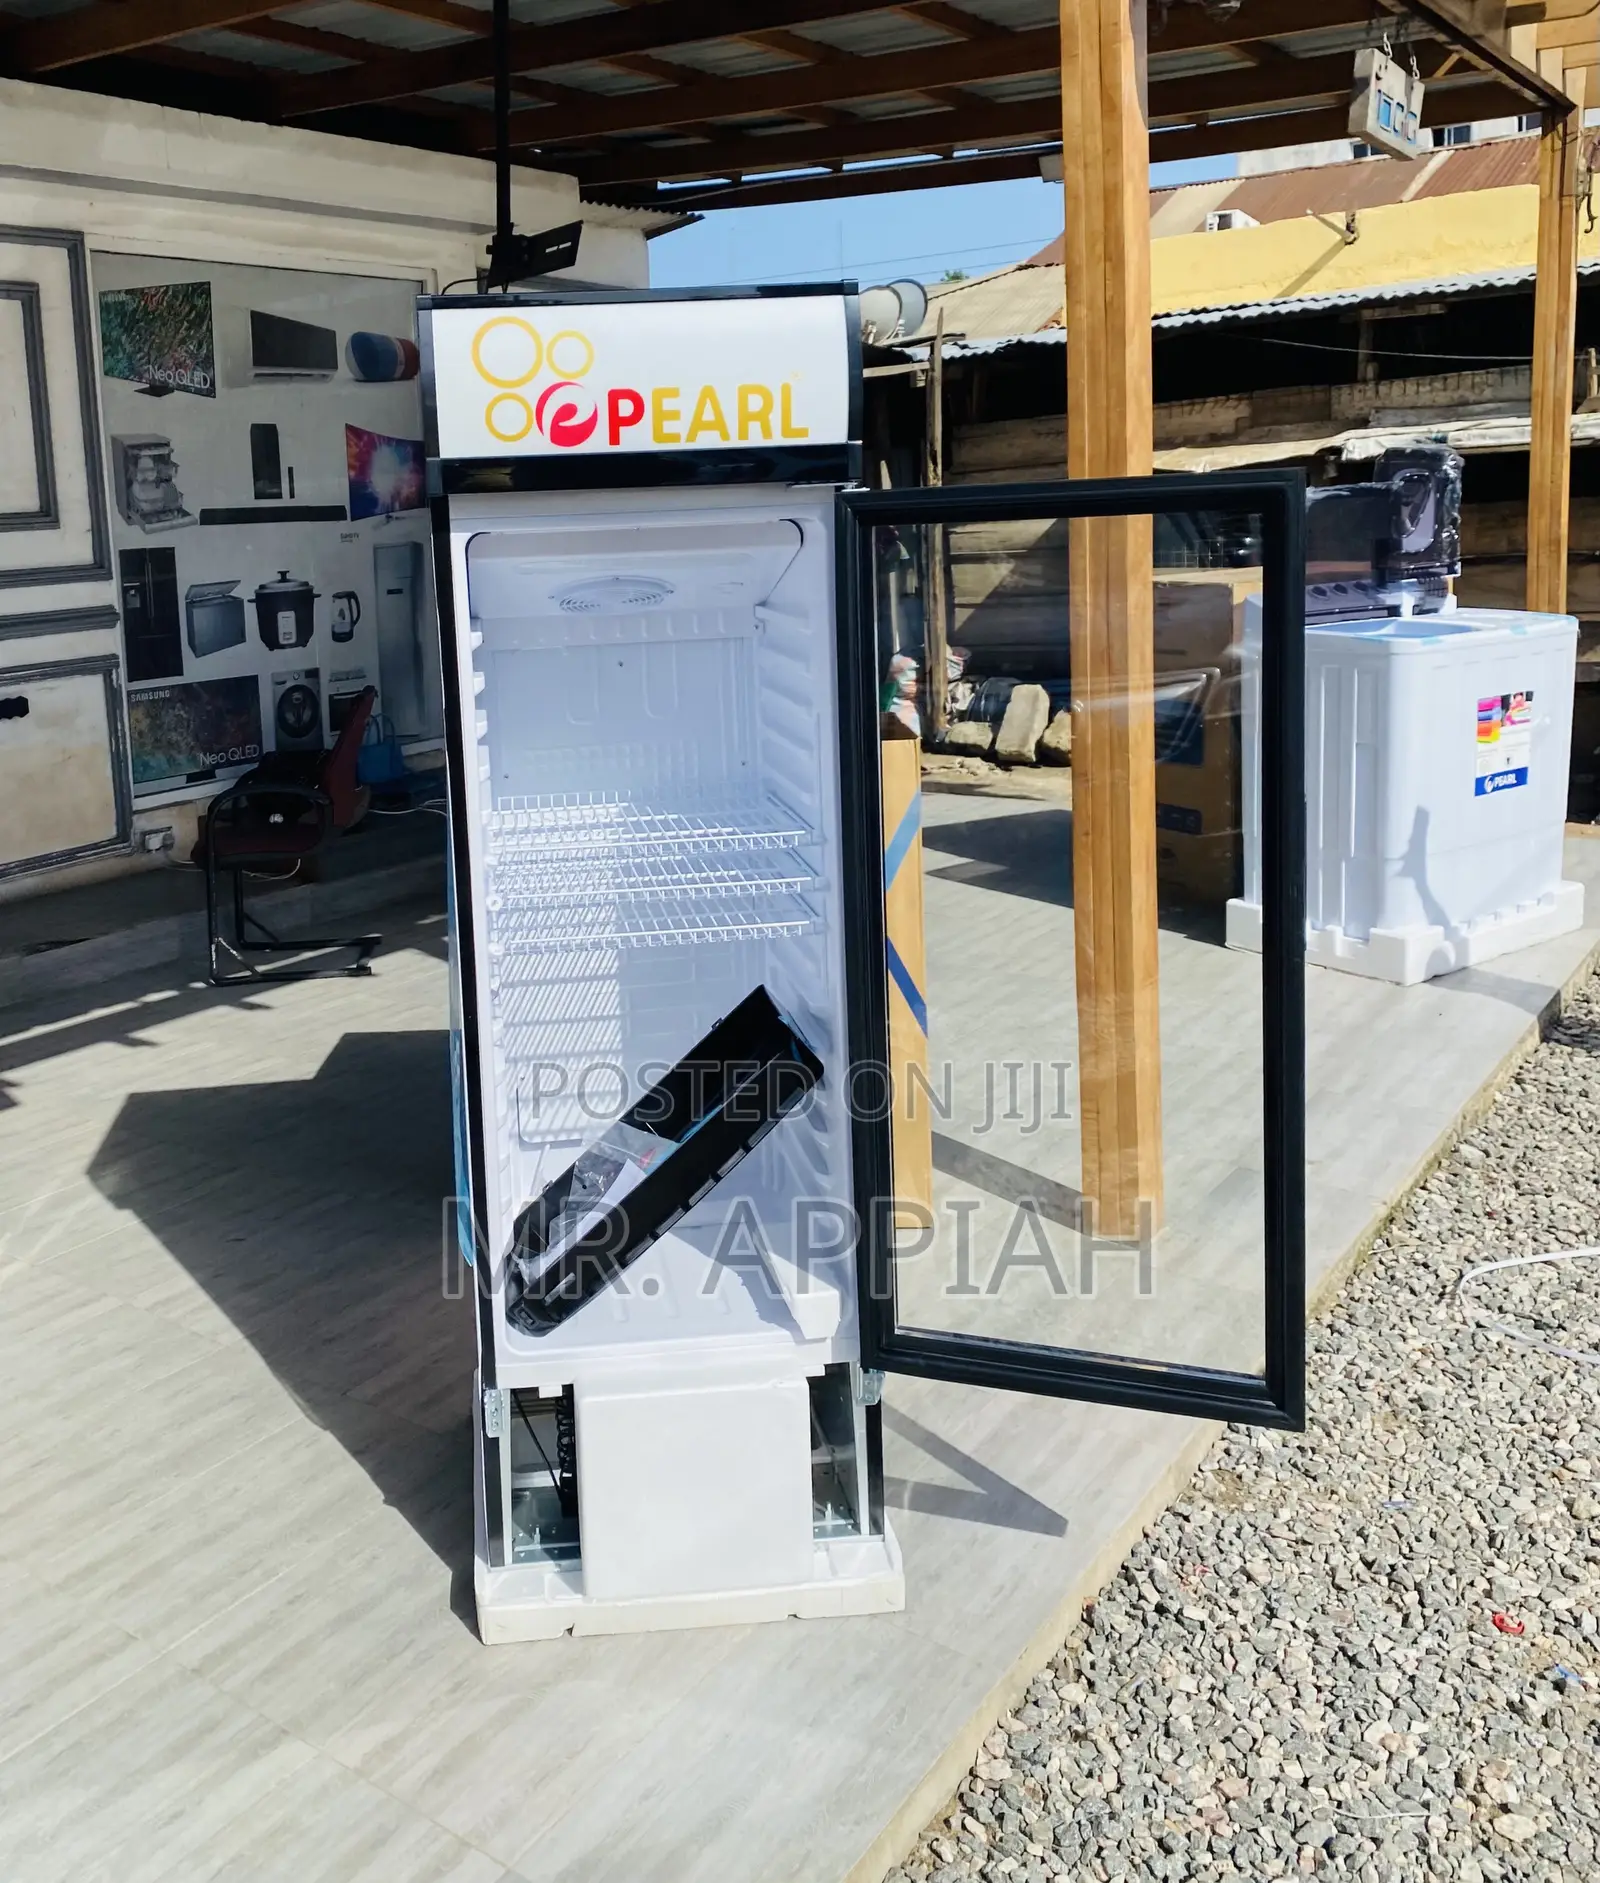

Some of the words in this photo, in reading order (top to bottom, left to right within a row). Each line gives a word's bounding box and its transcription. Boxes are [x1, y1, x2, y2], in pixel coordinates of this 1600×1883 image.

[149, 365, 173, 381] Neo
[176, 369, 210, 389] QLED
[607, 382, 809, 446] PEARL
[131, 690, 170, 702] SAMSUNG
[200, 751, 226, 766] Neo
[228, 744, 260, 761] QLED
[1493, 773, 1518, 788] PEARL
